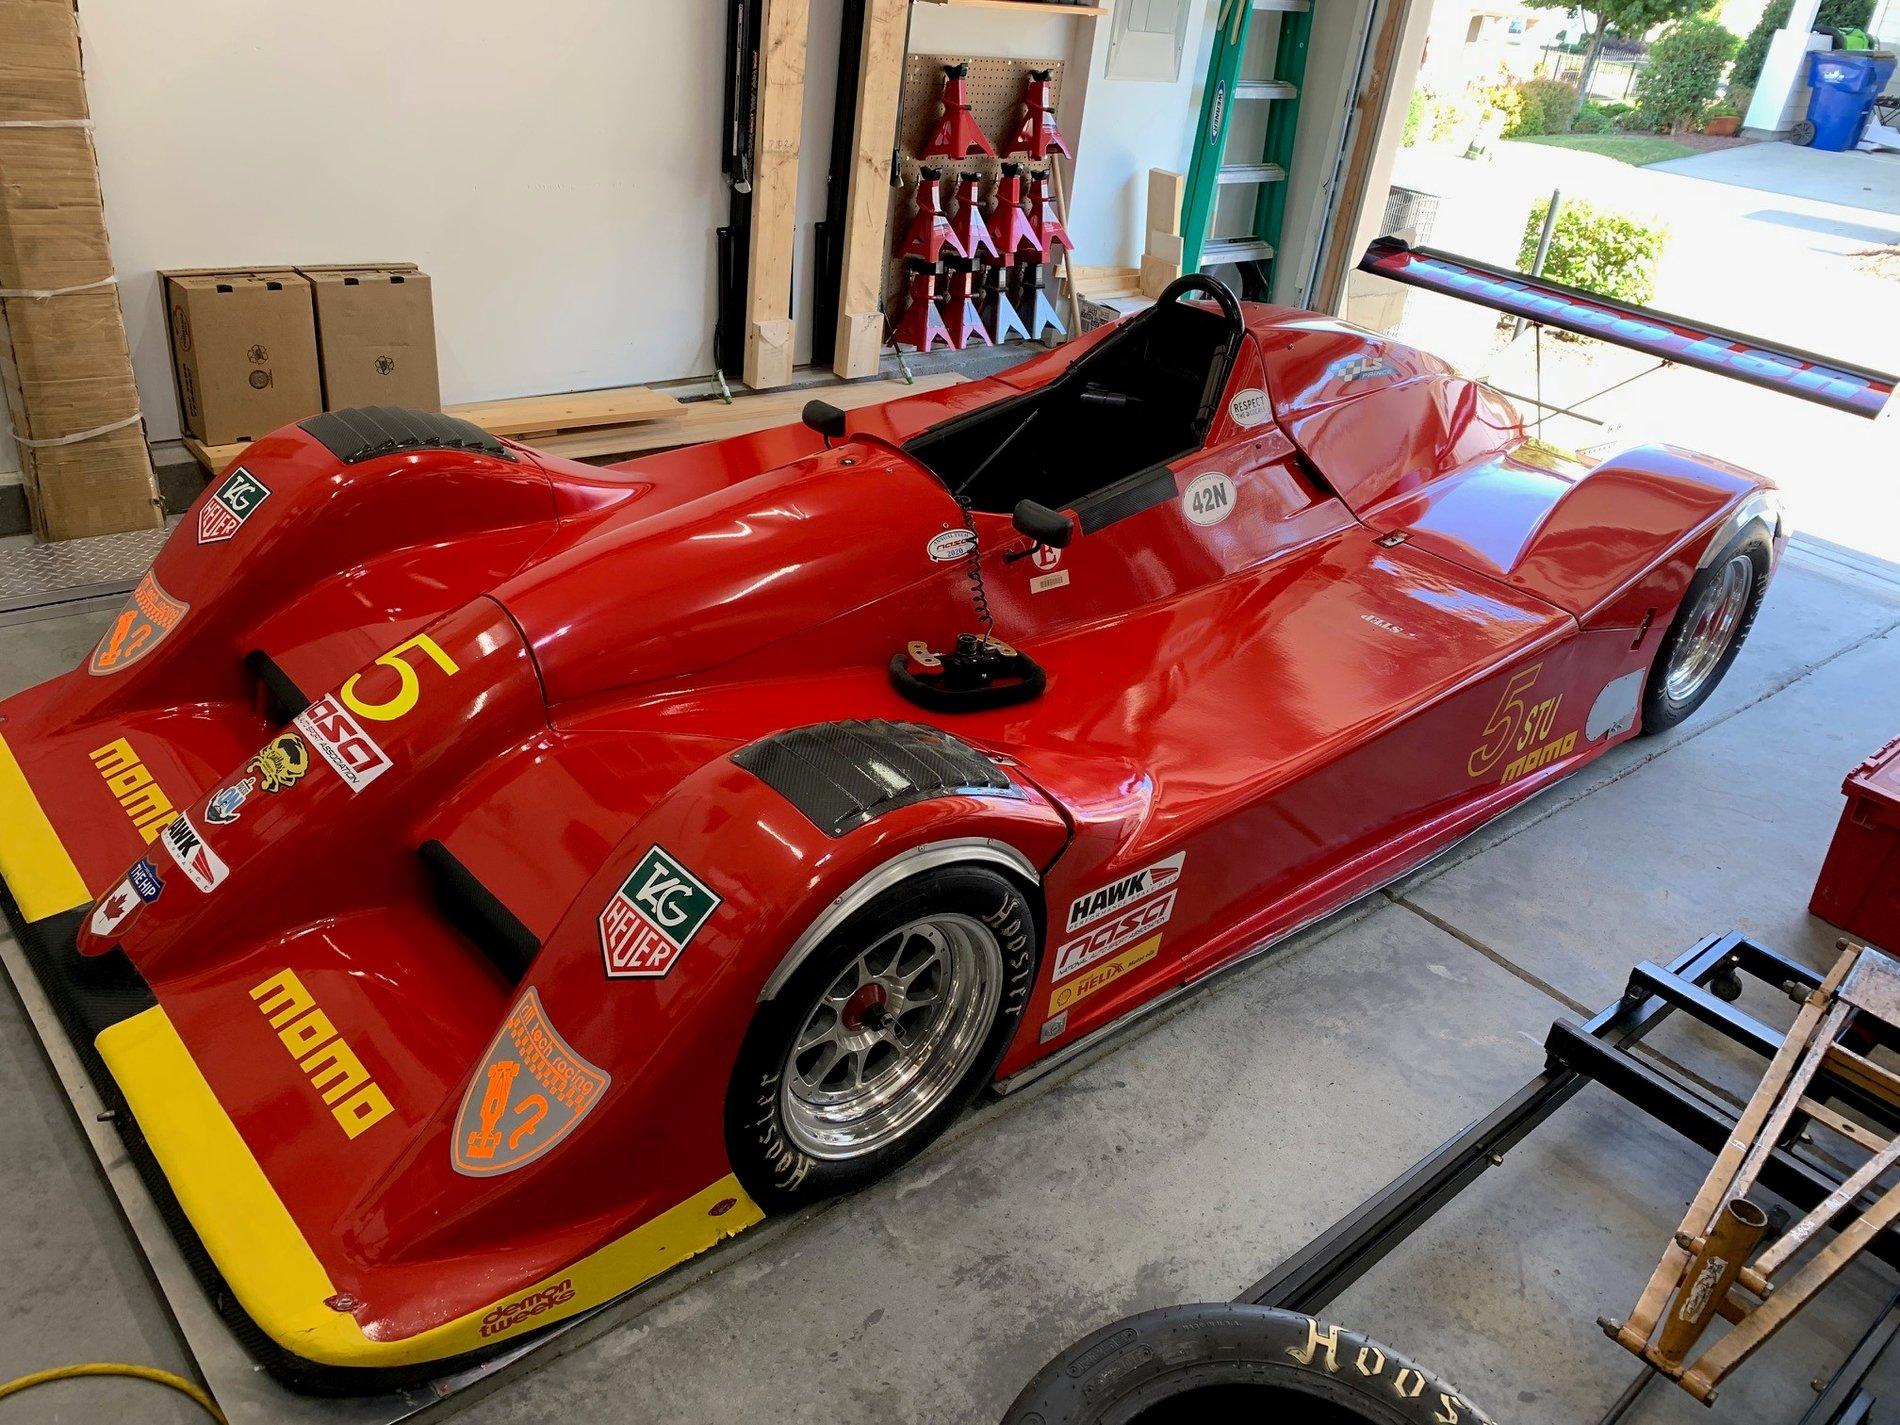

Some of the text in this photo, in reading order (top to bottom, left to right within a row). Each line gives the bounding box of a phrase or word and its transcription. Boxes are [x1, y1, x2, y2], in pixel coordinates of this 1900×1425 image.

[1362, 358, 1383, 371] LS
[1234, 396, 1265, 414] RESPECT
[223, 476, 256, 511] TAG
[1192, 483, 1228, 514] 42N
[202, 500, 237, 538] HEUER
[947, 548, 964, 558] 2020
[341, 633, 460, 721] 5
[305, 699, 384, 774] asa
[1467, 662, 1543, 777] 5
[1517, 693, 1563, 751] STU
[319, 741, 360, 784] ASSOCIATION
[1500, 730, 1578, 785] momo
[166, 817, 200, 858] AWK
[130, 863, 142, 884] THE
[139, 876, 156, 897] HIP
[636, 861, 693, 927] TAG
[1071, 870, 1148, 923] HAWK
[606, 901, 671, 966] HEUER
[1059, 895, 1173, 969] nasa
[1076, 962, 1125, 996] HELIX
[249, 968, 395, 1140] momo
[552, 1056, 595, 1095] racing
[479, 1289, 576, 1338] tweeks
[482, 1279, 572, 1324] demon
[1285, 1317, 1467, 1425] Hoos
